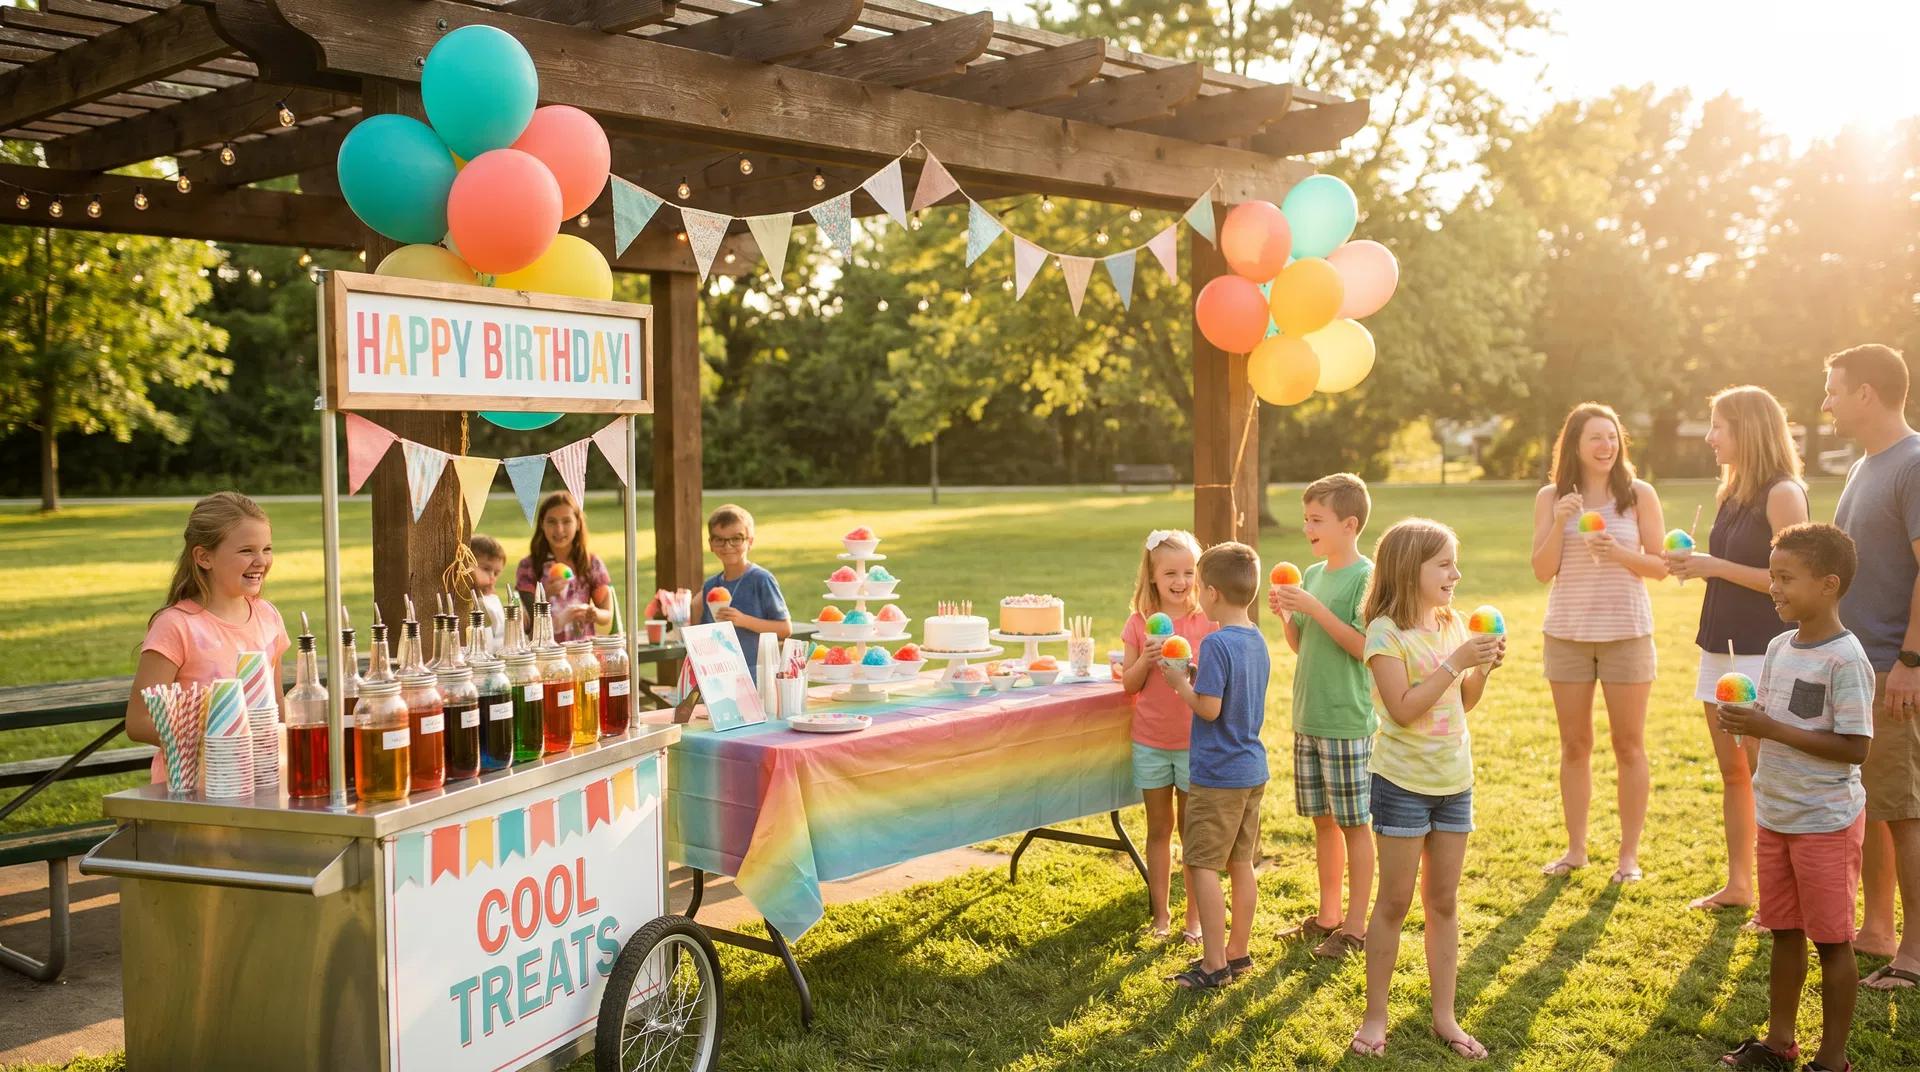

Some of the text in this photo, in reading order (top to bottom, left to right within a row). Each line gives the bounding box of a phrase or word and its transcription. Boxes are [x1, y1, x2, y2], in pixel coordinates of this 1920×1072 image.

[357, 311, 631, 385] HAPPY BIRTHDAY!
[476, 857, 599, 956] COOL
[450, 915, 622, 1048] TREATS
